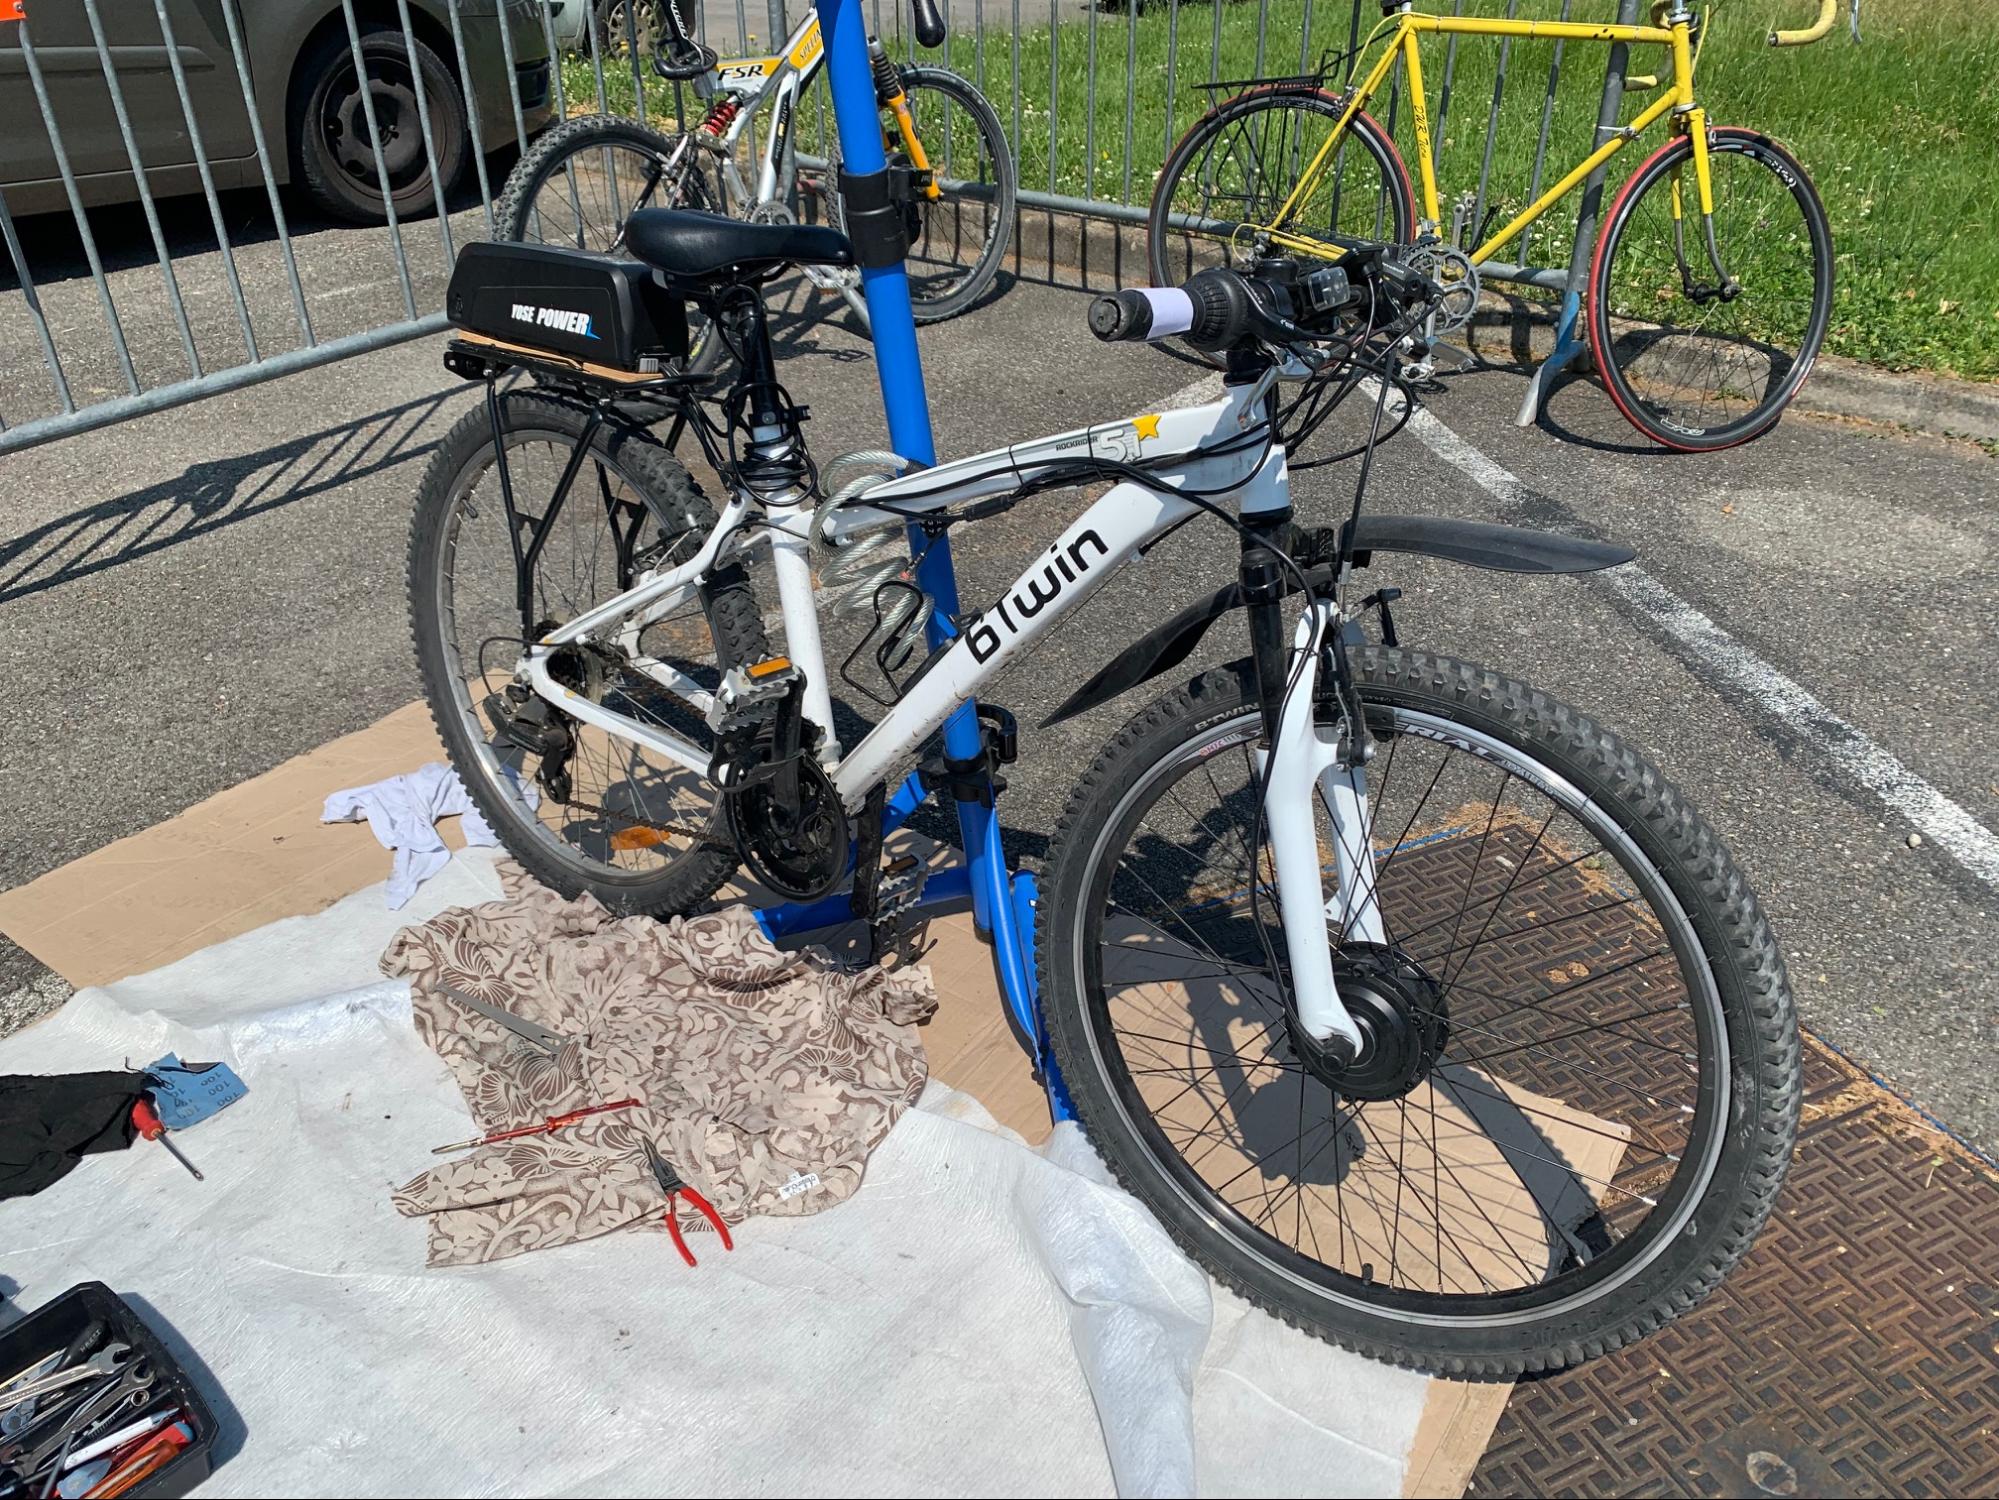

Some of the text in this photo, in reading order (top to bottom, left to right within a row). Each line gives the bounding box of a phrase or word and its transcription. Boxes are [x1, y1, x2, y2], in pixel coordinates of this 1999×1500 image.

[717, 64, 764, 81] FSR
[511, 303, 590, 336] YOSE POWER
[200, 1071, 222, 1087] 100
[207, 1080, 231, 1096] 100
[216, 1091, 240, 1107] 100
